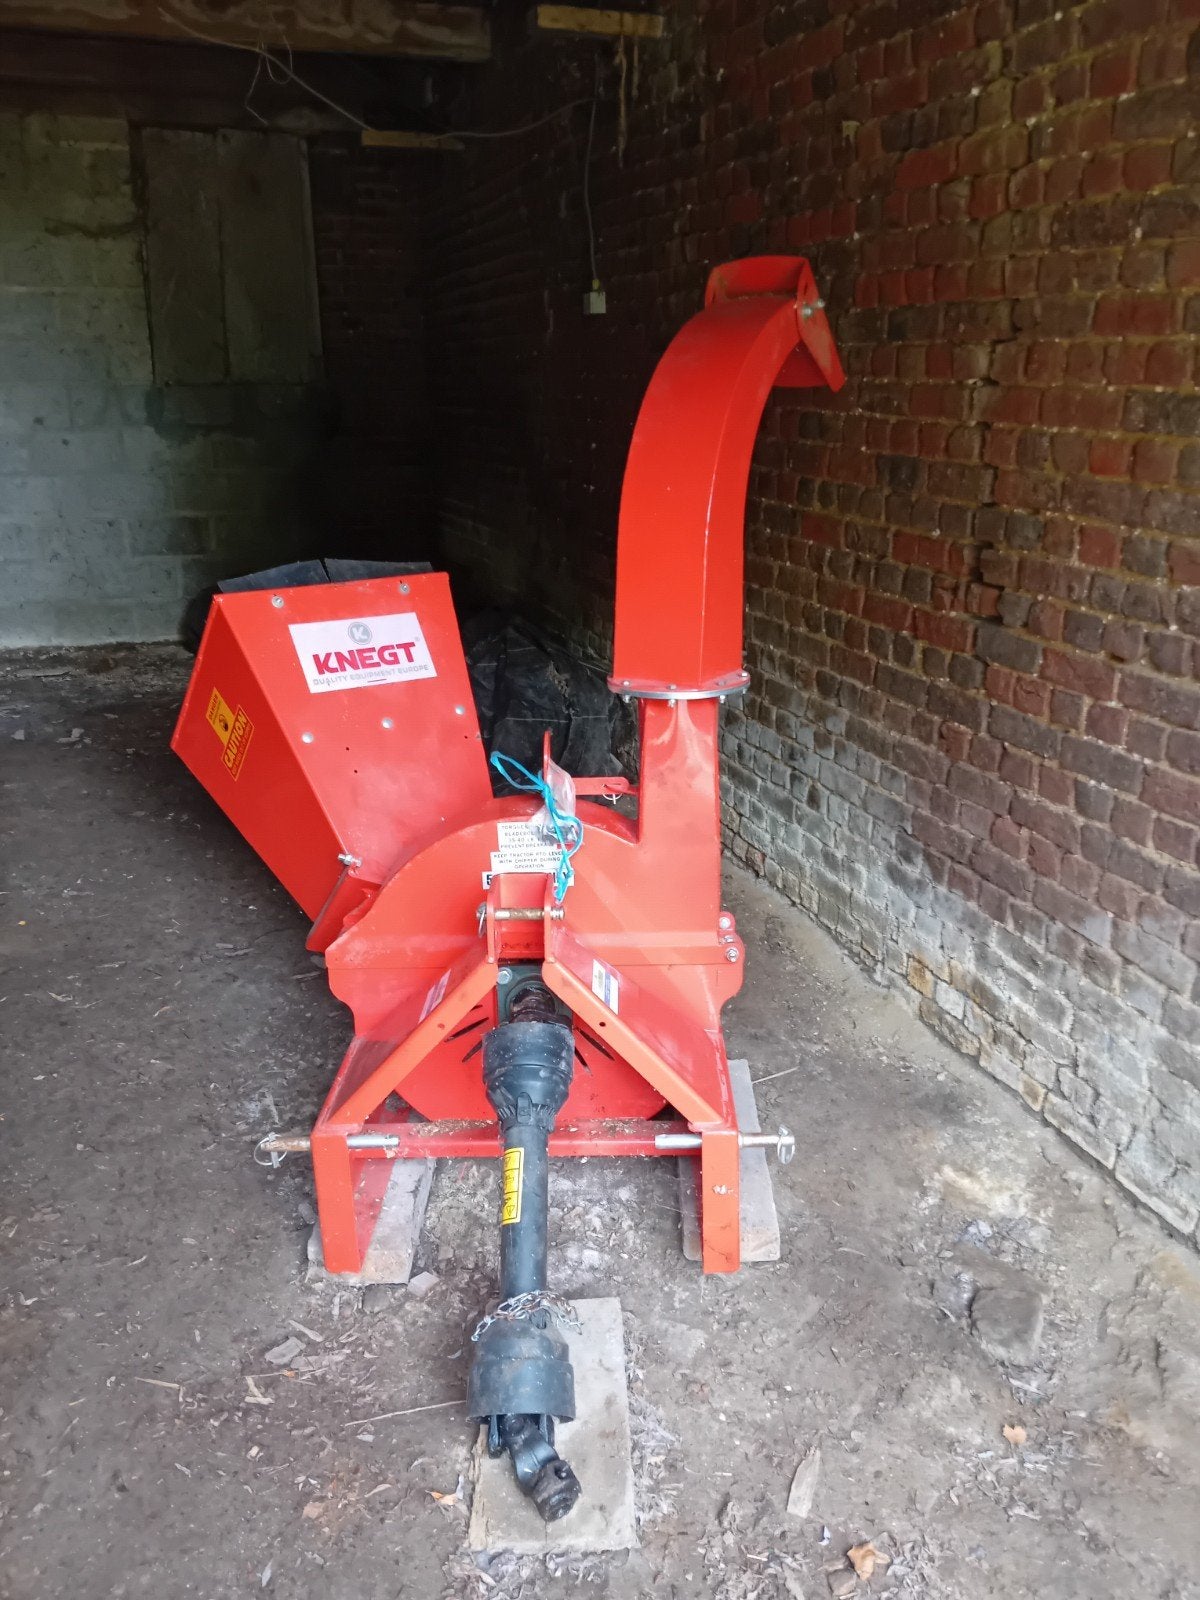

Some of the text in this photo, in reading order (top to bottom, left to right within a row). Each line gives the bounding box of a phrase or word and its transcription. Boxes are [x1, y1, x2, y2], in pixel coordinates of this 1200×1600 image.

[312, 642, 416, 675] KNEGT
[313, 664, 429, 686] QUALITY EQUIPMENT EUROPE
[224, 711, 248, 769] CAUTION
